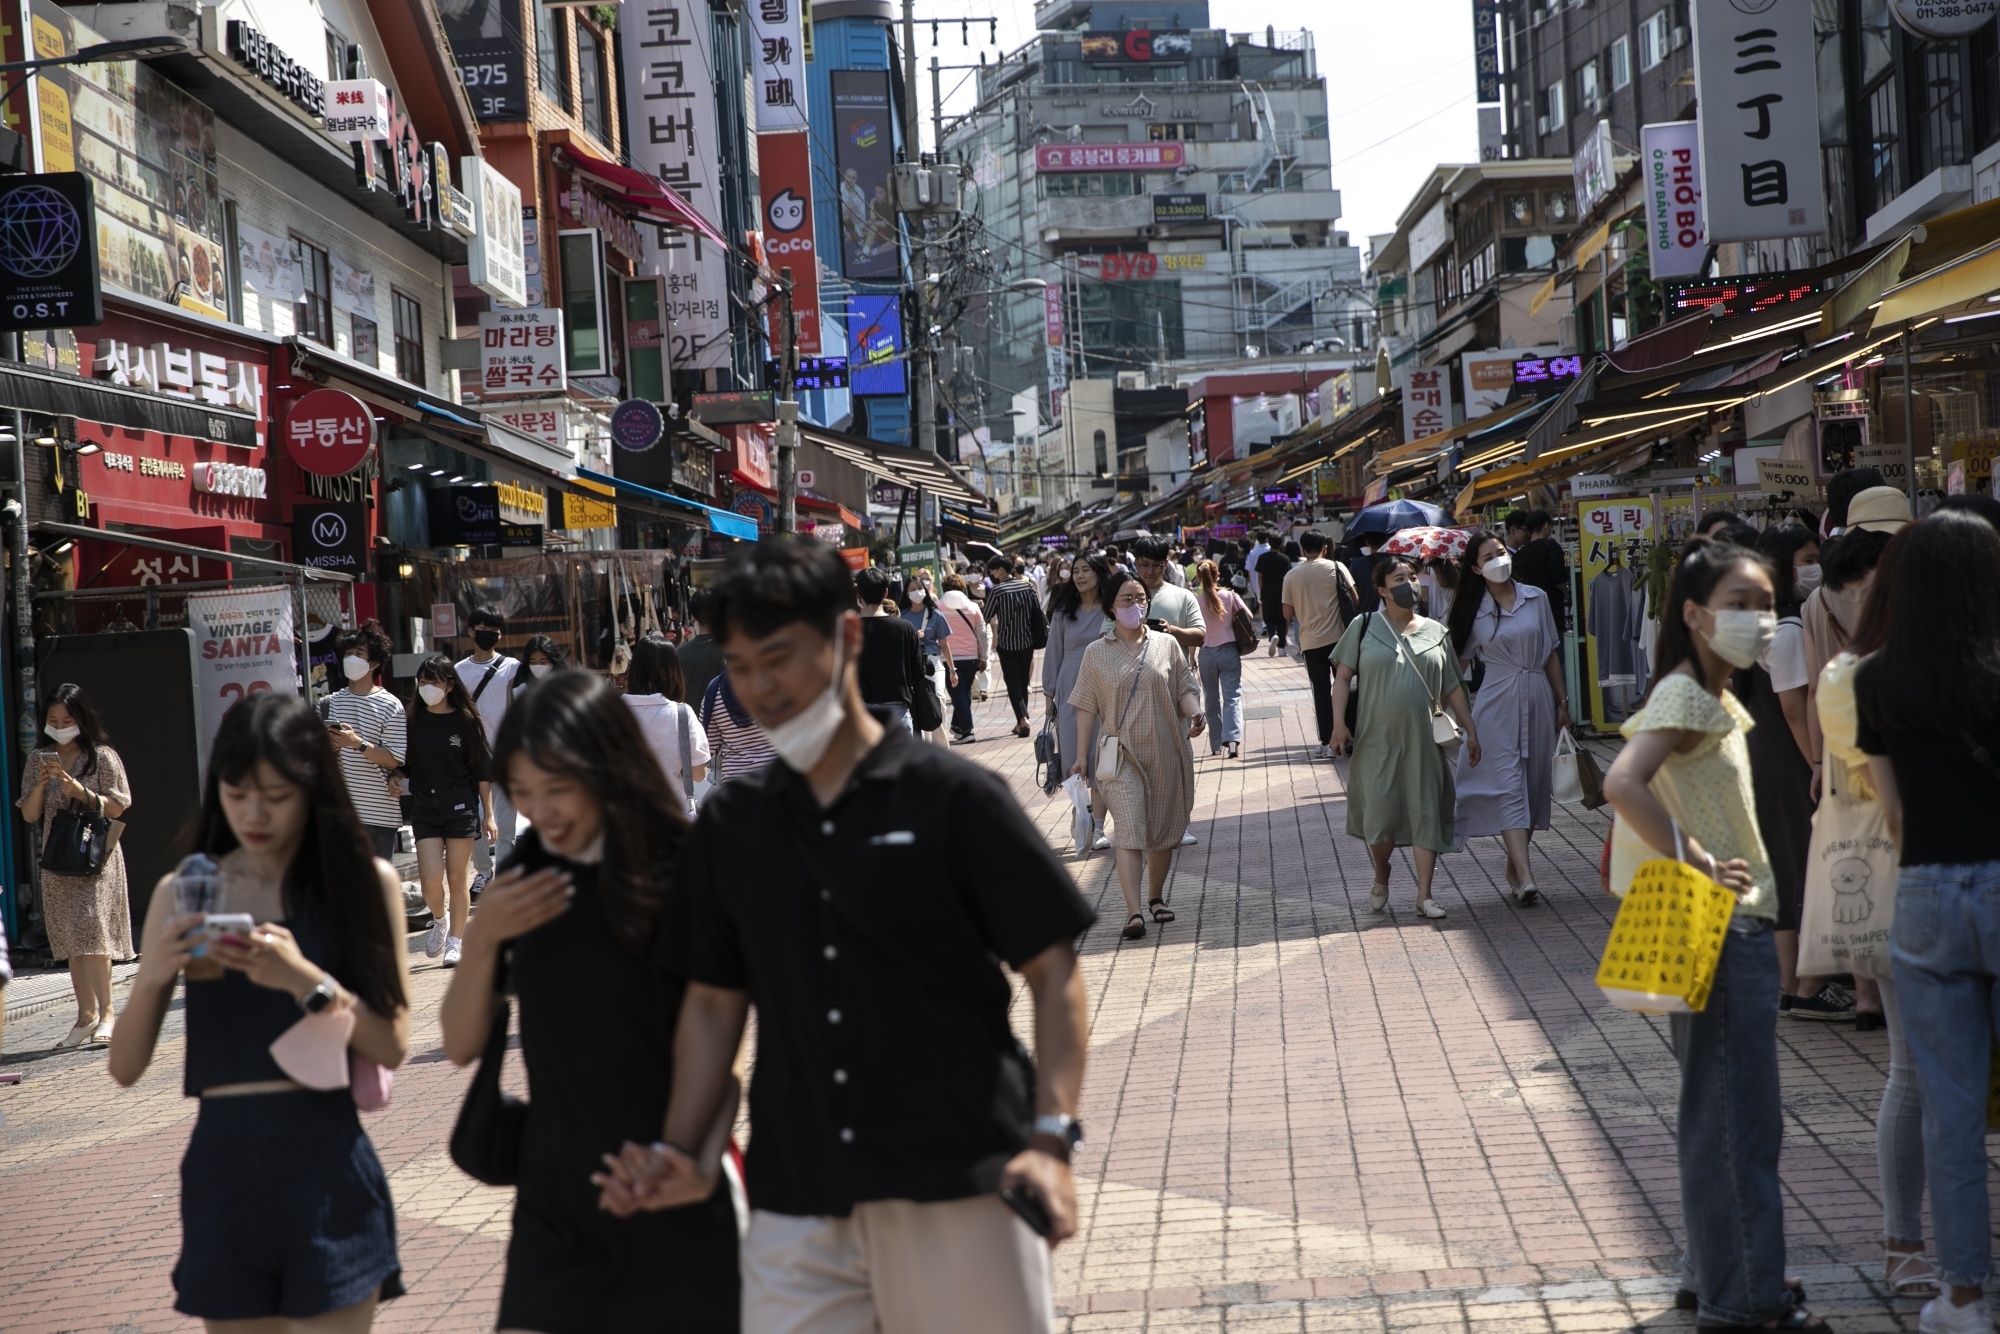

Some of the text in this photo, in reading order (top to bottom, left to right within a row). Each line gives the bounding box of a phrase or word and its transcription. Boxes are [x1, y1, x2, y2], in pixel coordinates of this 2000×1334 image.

[1916, 2, 1995, 20] 011-388-0474
[336, 91, 364, 105] 米线
[482, 98, 506, 114] 3F
[1733, 28, 1788, 207] 三丁目
[1069, 149, 1113, 165] 룸블리
[1117, 147, 1160, 164] 룸카페
[1101, 252, 1158, 281] DVD
[1164, 254, 1206, 271] 영화관
[668, 273, 698, 294] 홍대
[13, 301, 69, 319] O.S.T
[484, 325, 558, 349] 마라탕
[671, 334, 707, 363] 2F
[485, 364, 560, 388] 쌀국수
[503, 410, 557, 432] 전문점
[290, 416, 365, 448] 부동산
[1884, 448, 1903, 456] SALE
[1578, 479, 1635, 491] PHARMACY
[1764, 471, 1810, 486] ₩5,000
[76, 489, 90, 519] B1
[570, 504, 586, 514] for
[569, 512, 610, 525] school
[1591, 508, 1643, 534] 힐링
[507, 528, 534, 537] BAG
[305, 554, 356, 568] MISSHA
[245, 608, 265, 619] 빈티지
[209, 620, 273, 638] VINTAGE
[202, 634, 282, 660] SANTA
[1865, 837, 1895, 854] COME
[1830, 934, 1846, 945] ALL
[1849, 929, 1889, 946] SHAPES
[1831, 945, 1875, 960] AND SIZE
